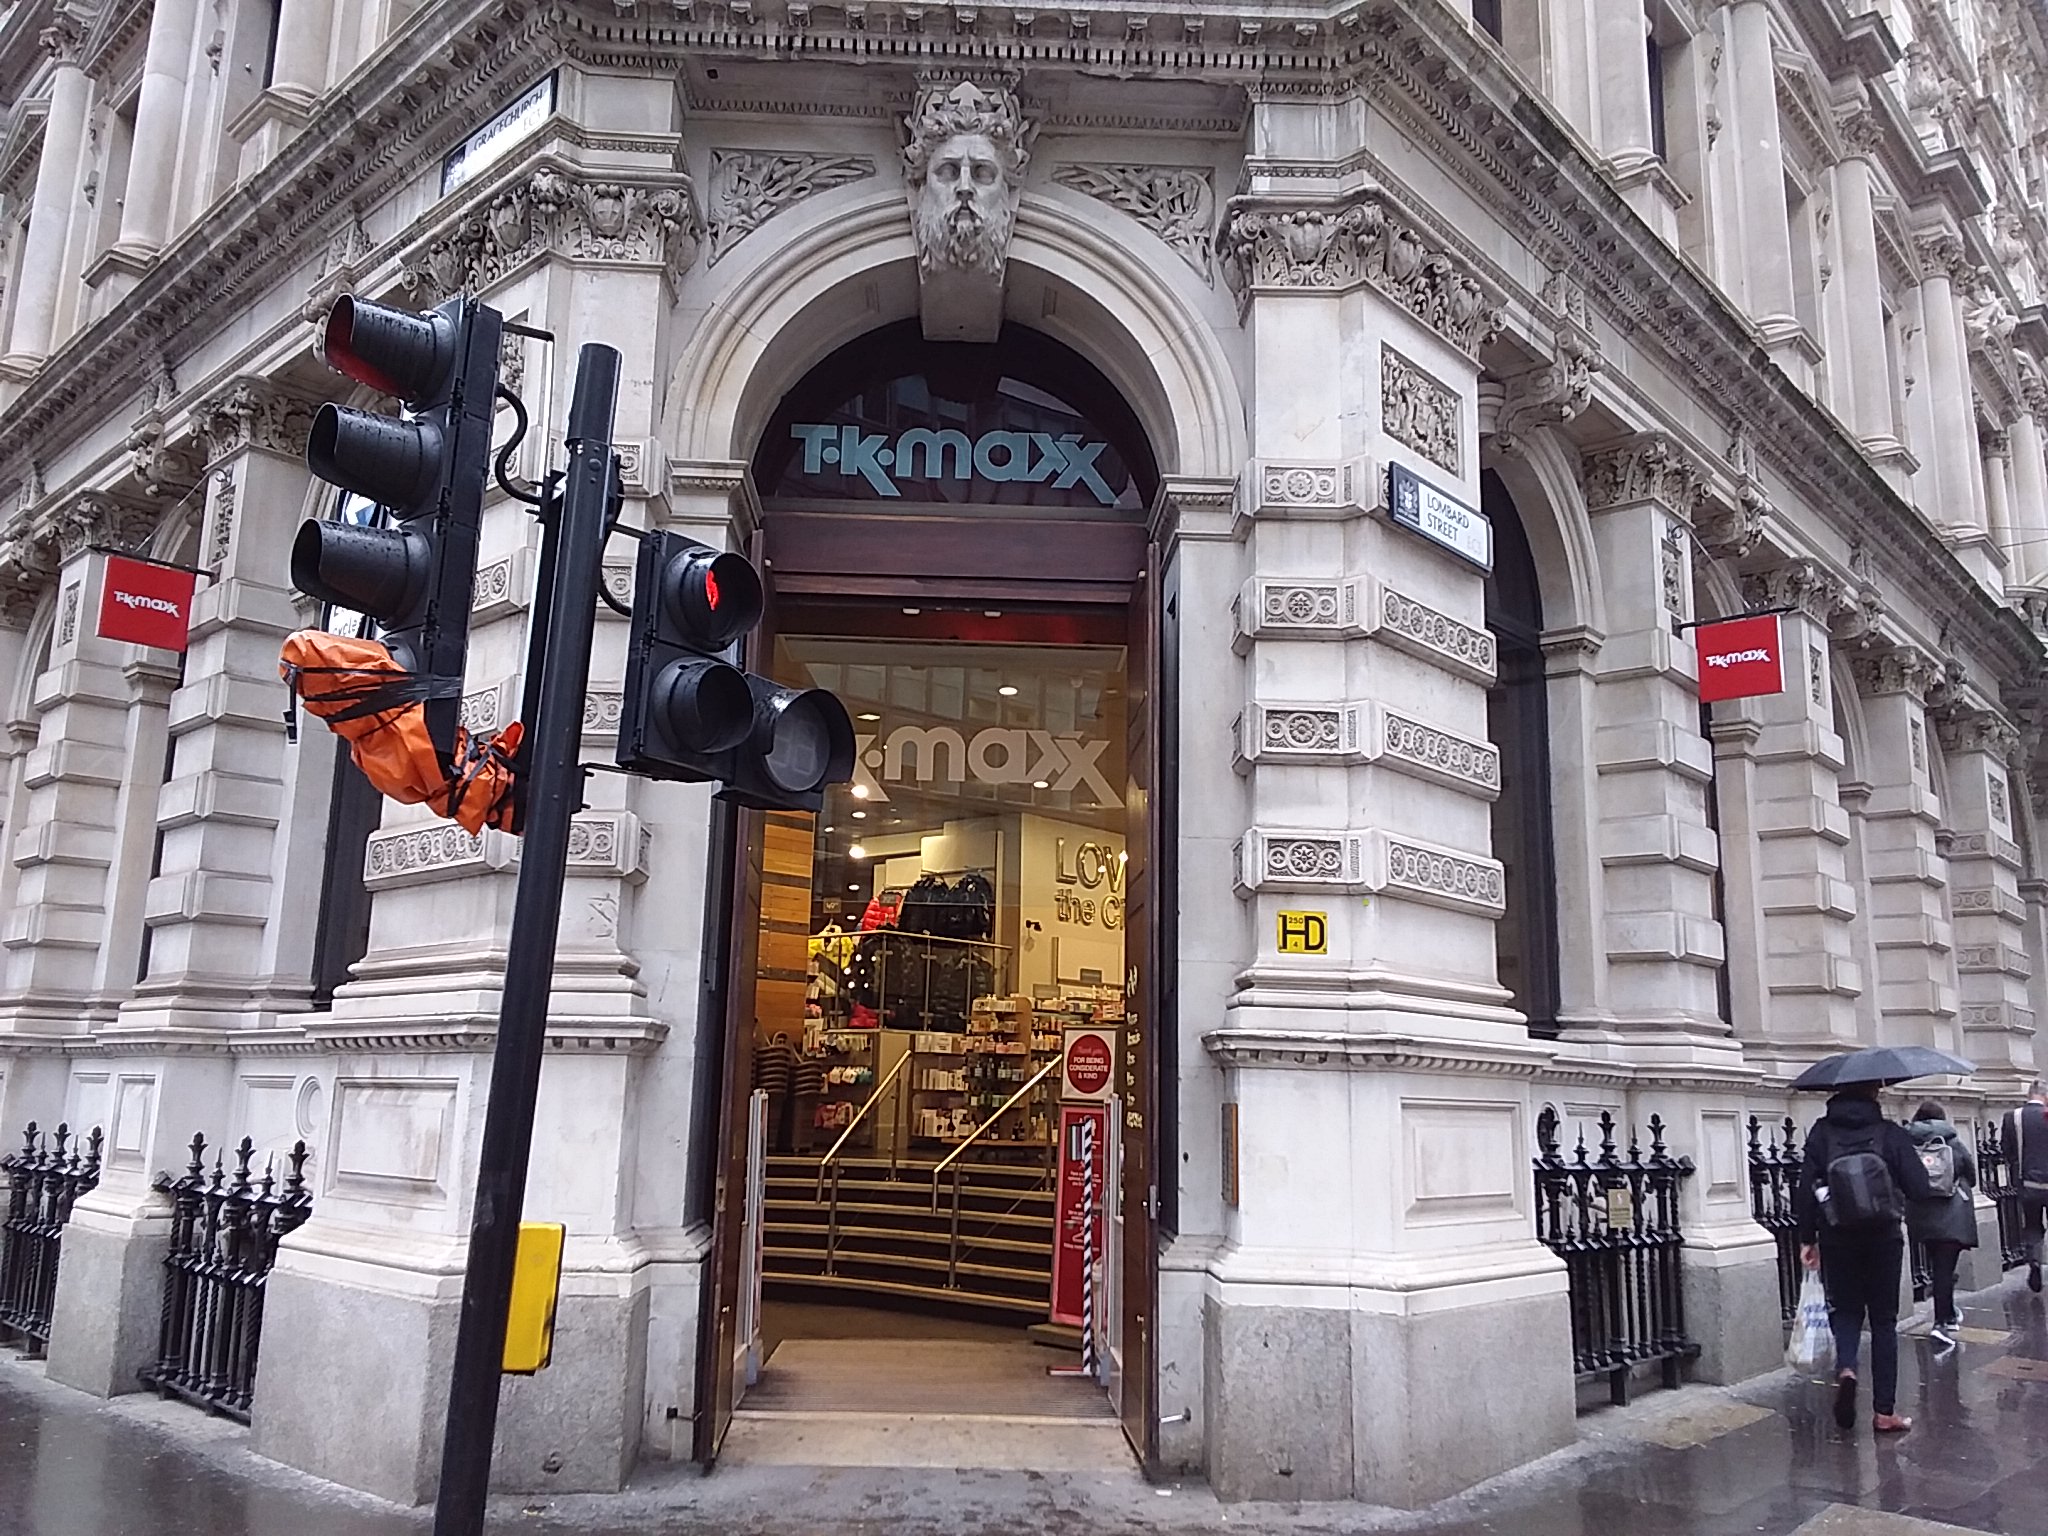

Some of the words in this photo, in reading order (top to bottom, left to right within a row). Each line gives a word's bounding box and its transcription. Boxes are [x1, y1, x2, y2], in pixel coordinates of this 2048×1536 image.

[474, 88, 543, 151] GRACECHURCH
[1427, 493, 1469, 529] LOMBARD
[1427, 512, 1459, 541] STREET
[1055, 837, 1127, 893] LOV
[1054, 888, 1096, 926] the
[1281, 914, 1325, 951] HD
[1069, 1064, 1109, 1073] CONSIDERATE
[1073, 1056, 1085, 1064] FOR
[1086, 1056, 1104, 1064] BEING
[1083, 1072, 1098, 1080] KIND
